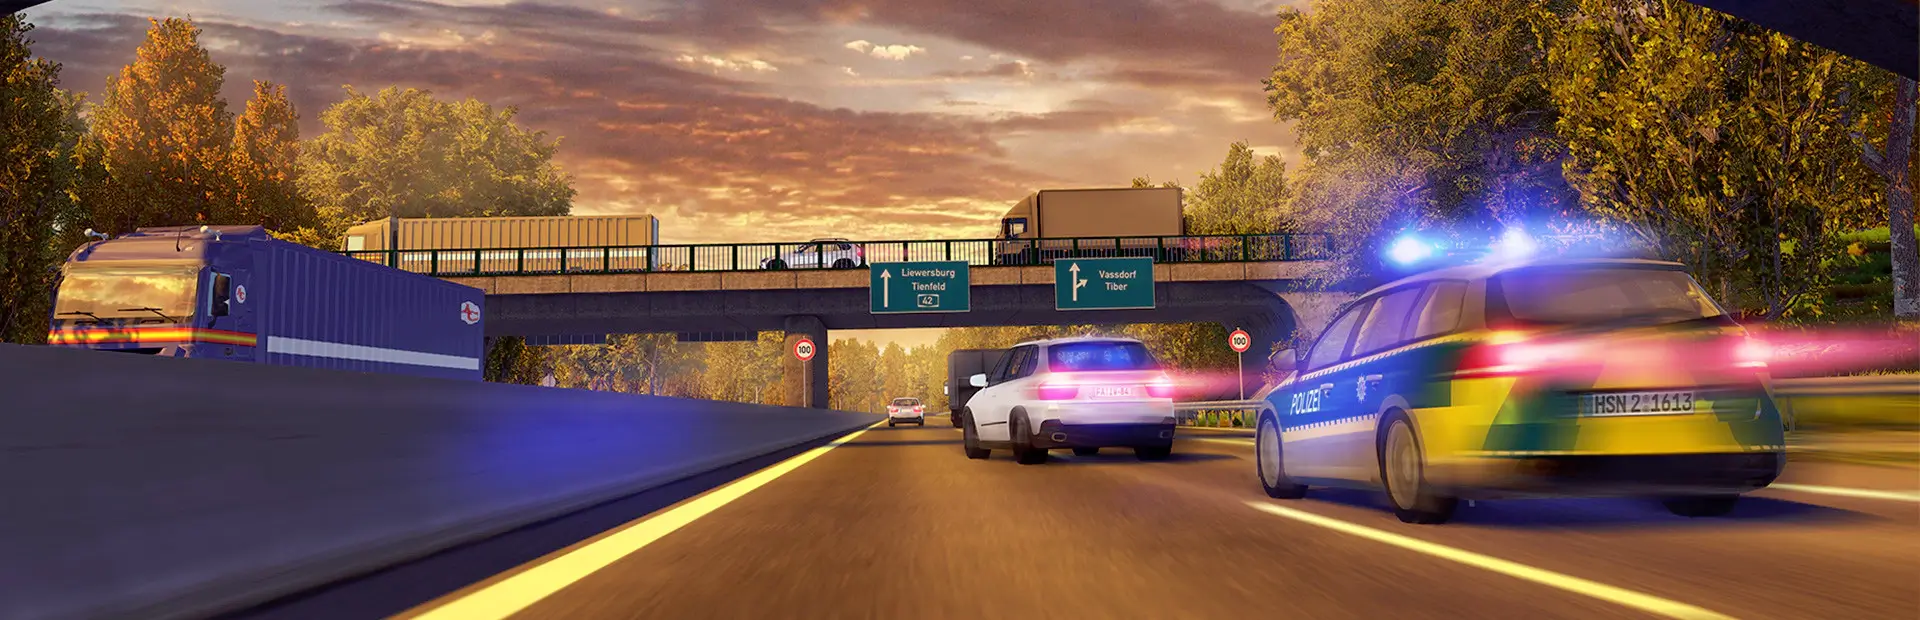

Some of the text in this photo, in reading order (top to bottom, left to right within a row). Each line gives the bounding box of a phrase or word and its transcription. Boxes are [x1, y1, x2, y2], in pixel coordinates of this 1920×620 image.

[901, 268, 955, 279] Liewersburg
[1099, 270, 1137, 279] Vassdorf
[912, 281, 946, 291] Tienfeld
[1105, 281, 1128, 291] Tiber
[922, 296, 933, 305] 42
[1233, 336, 1246, 345] 100
[798, 345, 811, 354] 100
[1290, 388, 1321, 415] POLIZEI
[1595, 393, 1692, 414] HSN 2 1613
